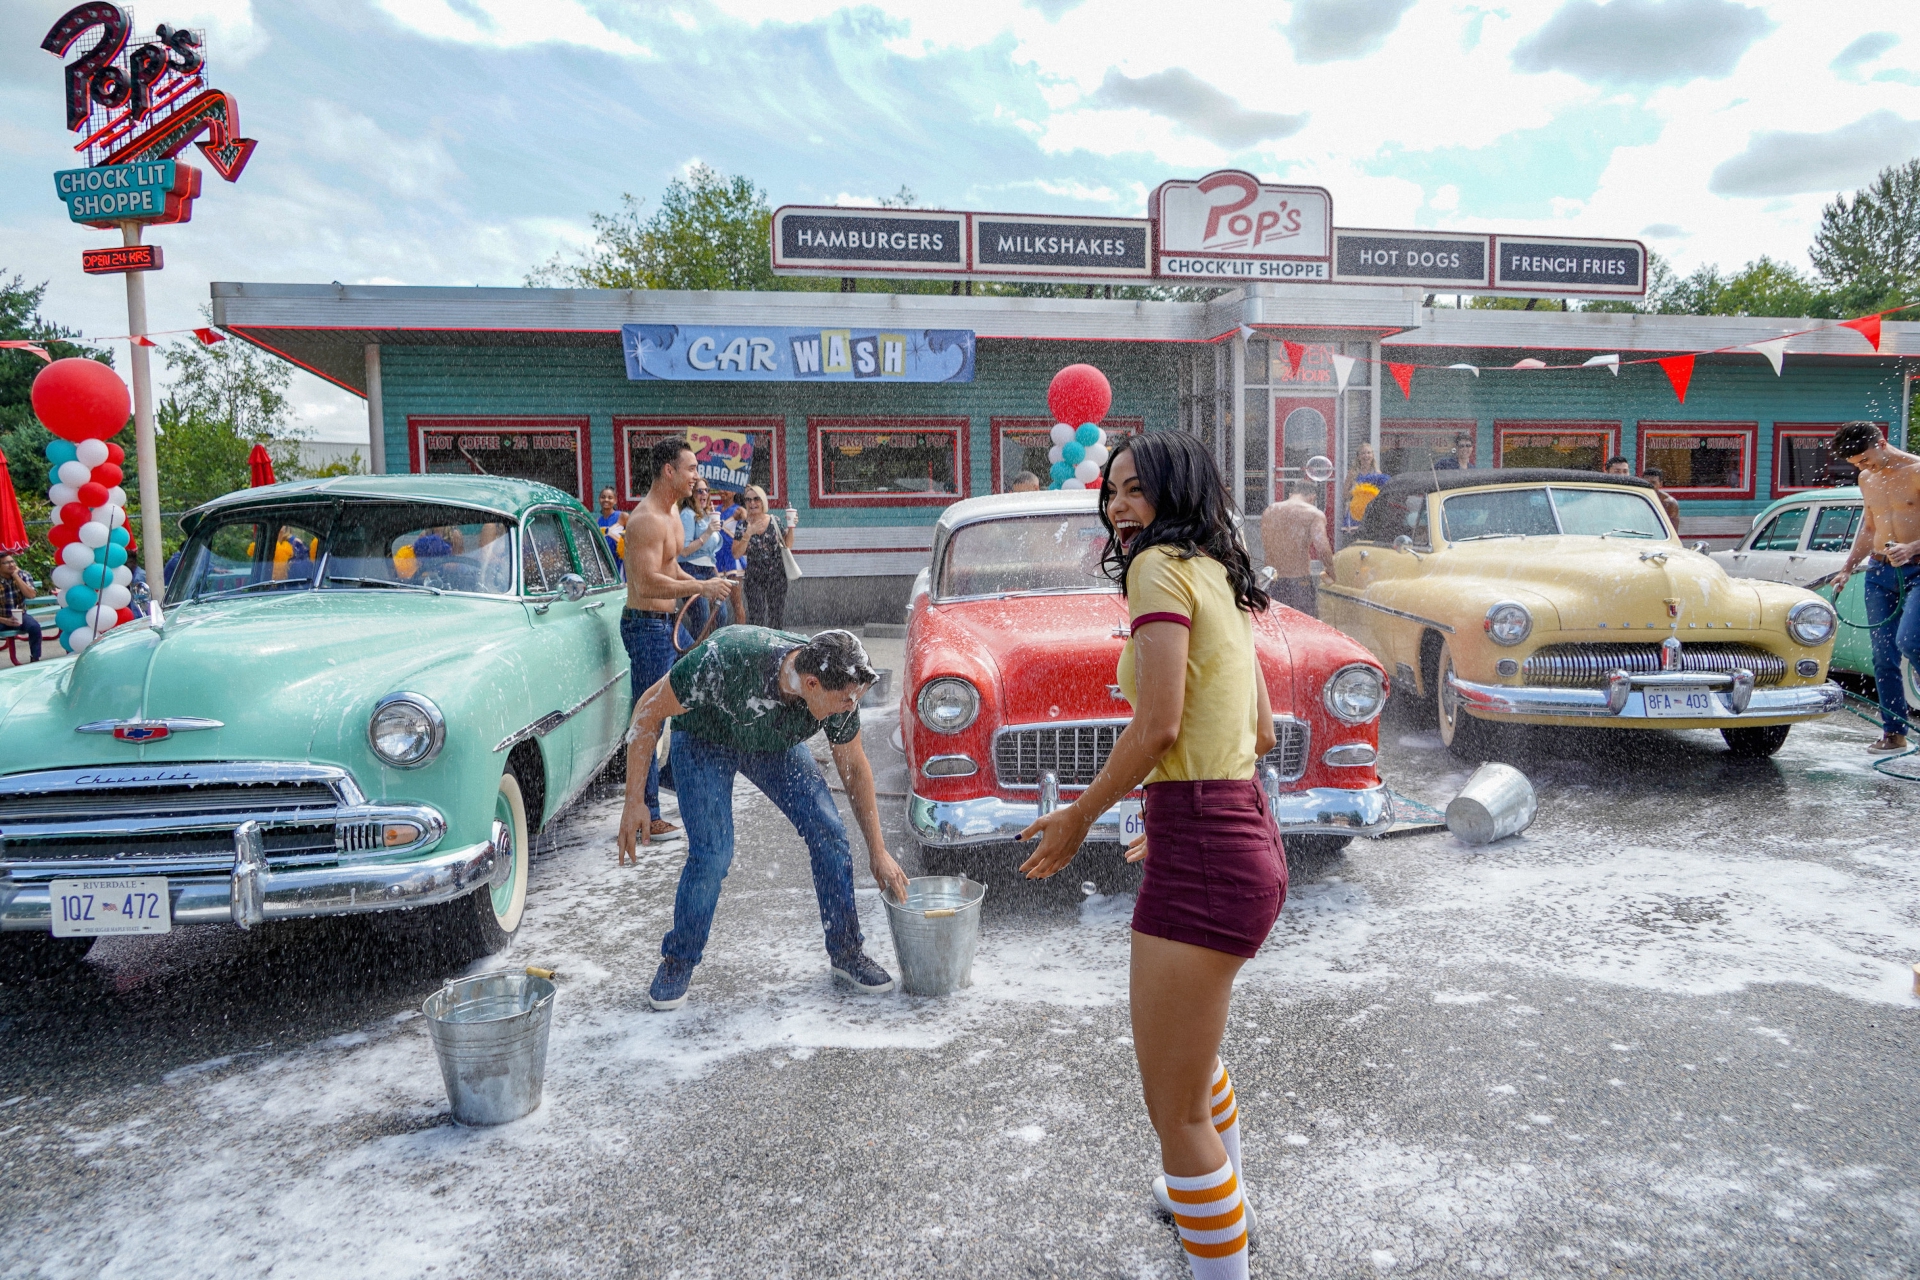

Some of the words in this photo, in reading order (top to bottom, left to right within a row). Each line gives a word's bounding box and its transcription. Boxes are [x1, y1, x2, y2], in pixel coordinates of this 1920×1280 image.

[59, 164, 167, 193] CHOCK'LIT
[73, 190, 153, 216] SHOPPE
[797, 229, 944, 251] HAMBURGERS
[997, 235, 1126, 256] MILKSHAKES
[83, 254, 111, 267] OPEN
[111, 252, 127, 265] 24
[1167, 258, 1255, 277] CHOCK'LIT
[1259, 260, 1324, 278] SHOPPE
[1359, 248, 1399, 267] HOT
[1406, 250, 1460, 269] DOGS
[1511, 254, 1578, 274] FRENCH
[1582, 257, 1627, 276] FRIES
[687, 336, 778, 372] CAR
[792, 333, 904, 376] WASH
[427, 435, 453, 450] HOT
[457, 435, 501, 450] COFFEE
[512, 435, 528, 450] 24
[532, 435, 573, 450] HOURS
[830, 434, 879, 448] BURGERS
[924, 434, 949, 448] POP
[697, 463, 750, 488] BARGAIN
[1648, 694, 1672, 709] 8FA
[1686, 693, 1709, 709] 403
[75, 771, 199, 785] Chevrolet
[82, 880, 138, 890] RIVERDALE
[60, 894, 96, 921] 1QZ
[122, 892, 160, 919] 472
